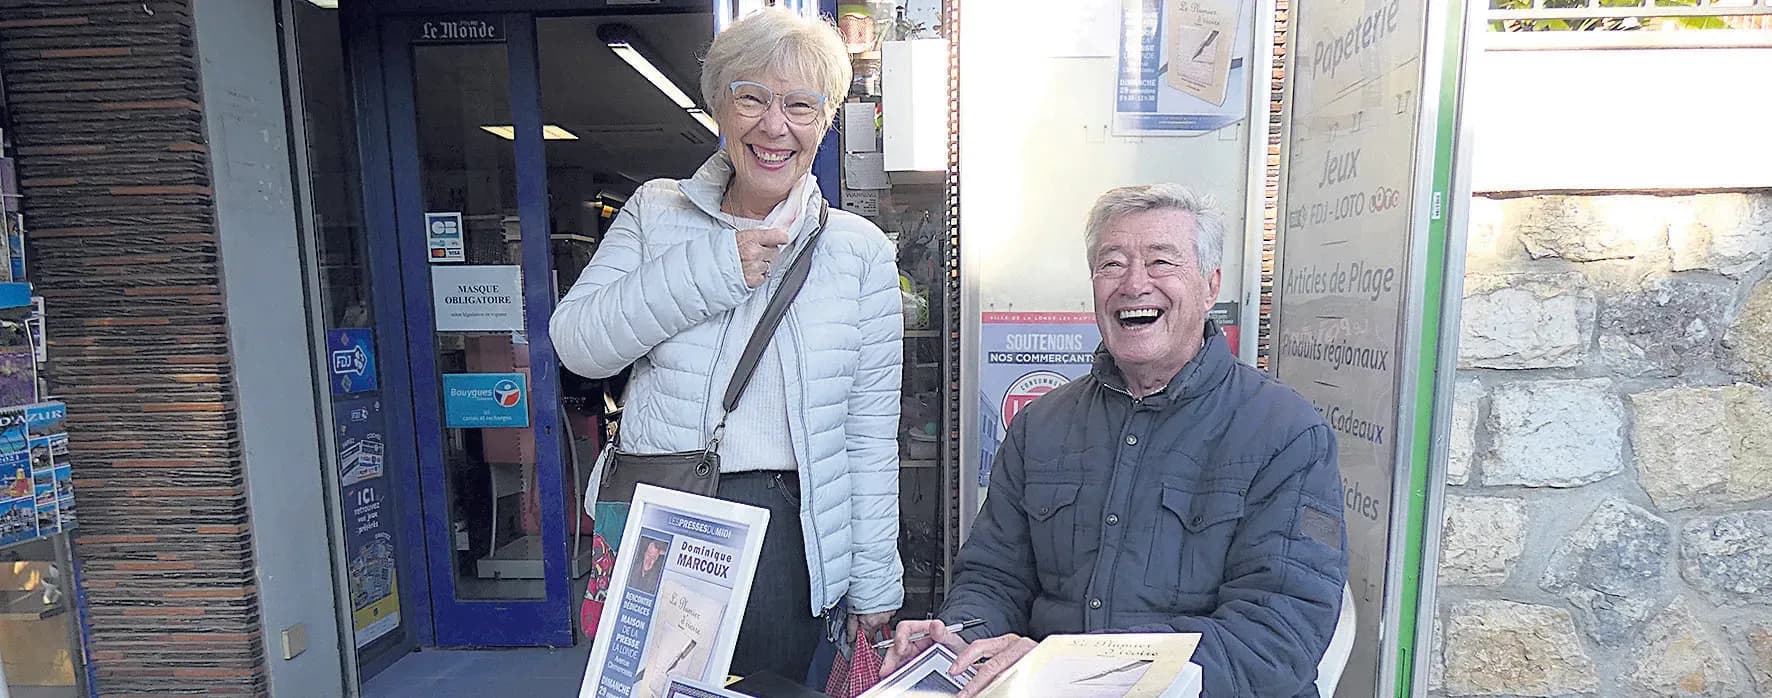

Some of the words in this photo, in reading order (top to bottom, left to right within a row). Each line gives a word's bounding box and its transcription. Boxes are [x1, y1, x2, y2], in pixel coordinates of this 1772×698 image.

[422, 22, 437, 38] Le
[440, 22, 495, 38] Monde
[1313, 0, 1399, 80] Papeterie
[1319, 148, 1361, 188] Jeux
[1310, 201, 1328, 225] FDJ
[1335, 192, 1365, 220] LOTO
[1286, 264, 1327, 294] Articles
[1329, 263, 1346, 293] de
[1349, 261, 1394, 301] Plage
[445, 296, 511, 304] OBLIGATOIRE
[458, 285, 499, 299] MASQUE
[1006, 334, 1082, 351] SOUTENONS
[990, 353, 1013, 362] NOS
[1282, 333, 1322, 360] Produits
[1324, 338, 1388, 371] régionaux
[336, 356, 351, 368] FDJ
[450, 388, 492, 399] Bouygues
[1331, 406, 1384, 444] Cadeaux
[358, 487, 374, 506] ICI
[681, 541, 732, 563] Dominique
[677, 553, 730, 579] MARCOUX
[621, 614, 646, 630] MAISON
[622, 626, 631, 635] DE
[631, 629, 638, 638] LA
[616, 633, 641, 649] PRESSE
[612, 643, 620, 653] LA
[620, 645, 639, 660] LONDE
[598, 686, 607, 697] 29
[601, 675, 631, 696] DIMANCHE
